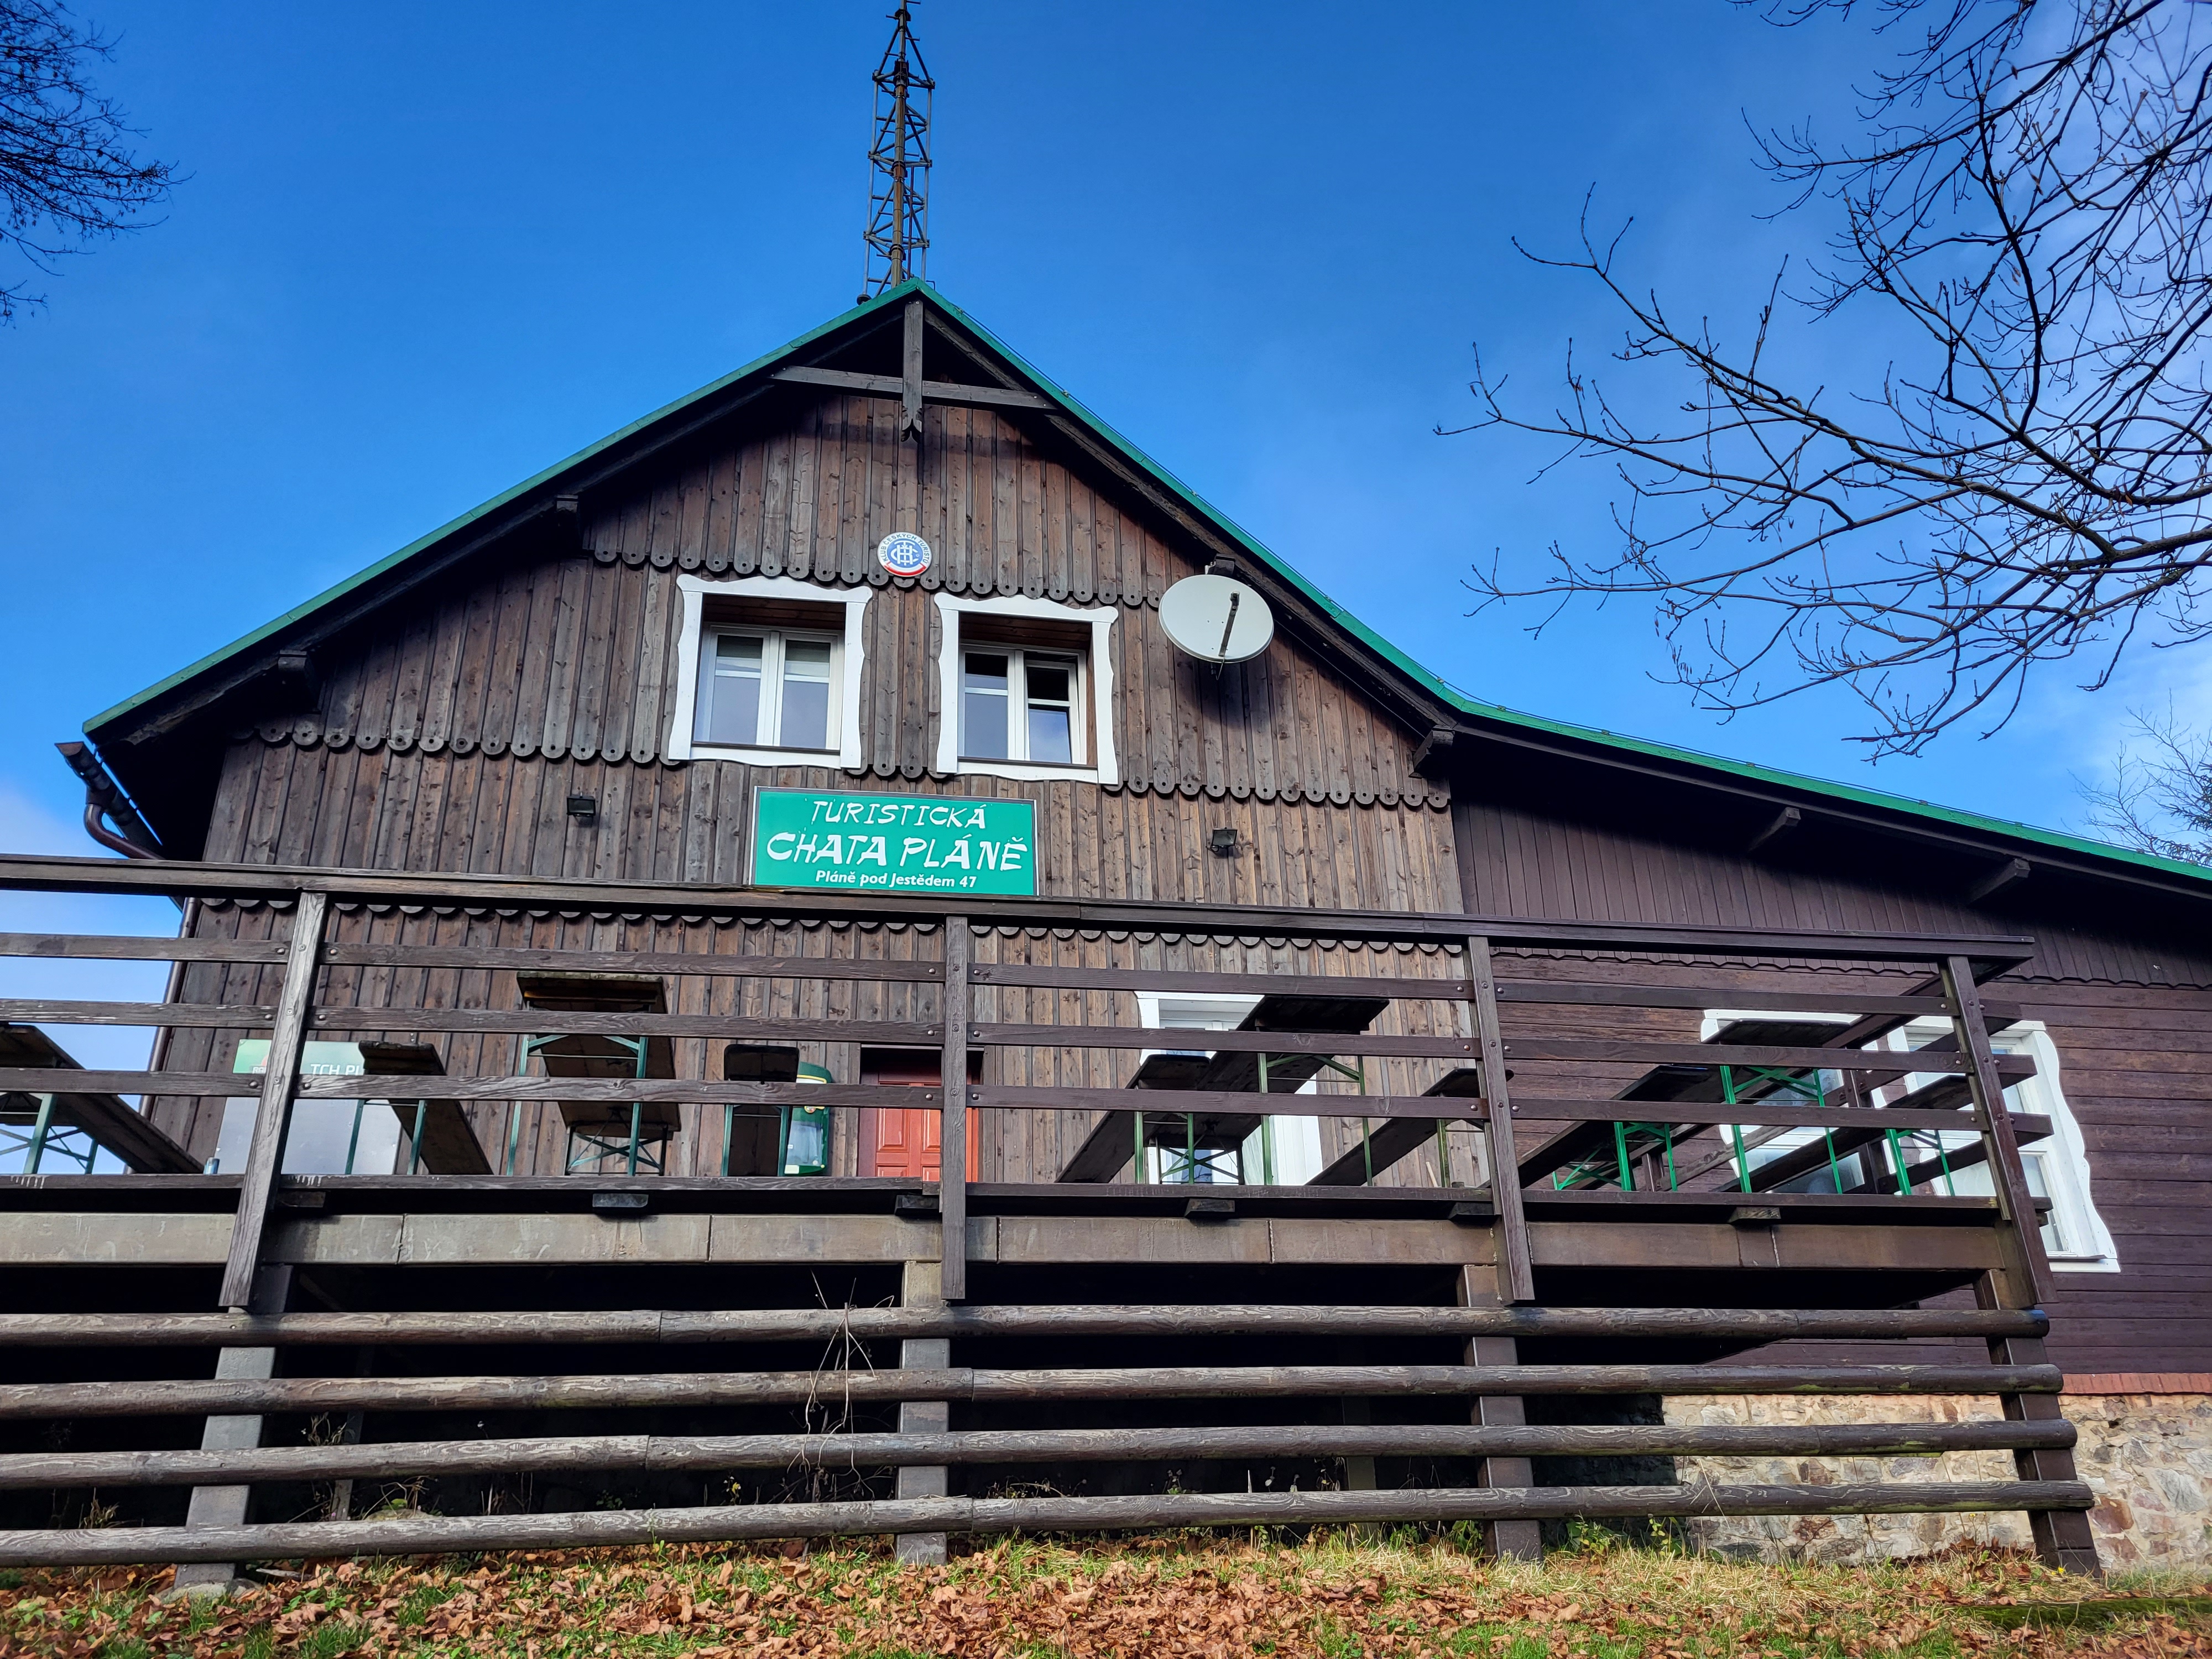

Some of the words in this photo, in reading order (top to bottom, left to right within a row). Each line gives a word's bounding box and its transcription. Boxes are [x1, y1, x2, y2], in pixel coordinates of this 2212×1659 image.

[880, 546, 888, 562] KLUB
[811, 801, 987, 829] TURISTICKÁ
[767, 832, 887, 866] CHATA
[899, 833, 1027, 872] PLÁNĚ
[815, 870, 856, 884] Pláně
[859, 873, 888, 887] pod
[959, 875, 977, 888] 47
